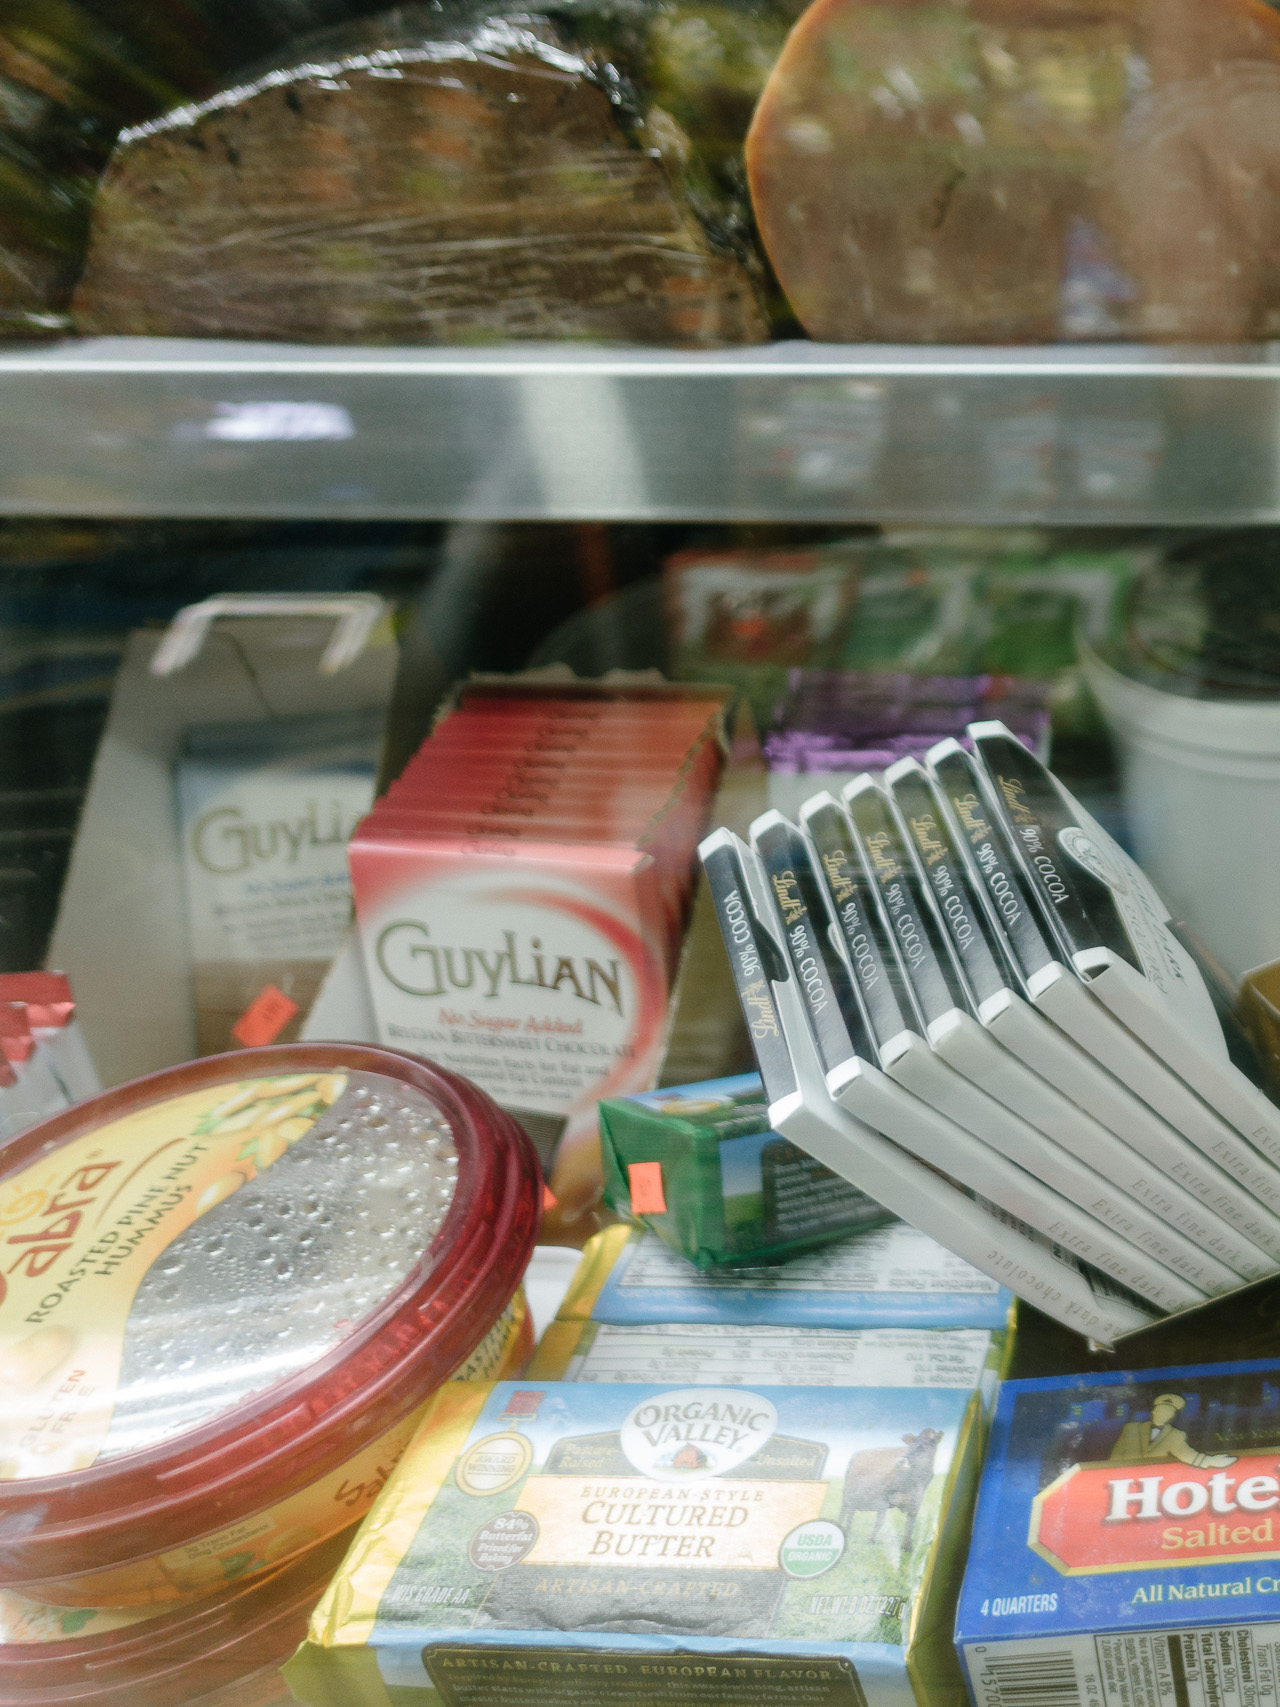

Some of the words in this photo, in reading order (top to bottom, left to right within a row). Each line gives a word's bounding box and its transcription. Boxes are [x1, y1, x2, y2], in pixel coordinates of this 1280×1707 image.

[866, 831, 895, 877] Lindt
[954, 793, 985, 839] Lindt
[976, 842, 1001, 875] 90%
[990, 872, 1023, 927] COCOA
[911, 813, 942, 860] Lindt
[932, 865, 955, 897] 90%
[944, 894, 976, 951] COCOA
[886, 883, 908, 916] 90%
[723, 889, 751, 945] COCOA
[823, 849, 853, 898] Lindt
[841, 902, 861, 935] 90%
[851, 933, 881, 992] COCOA
[772, 870, 800, 920] Lindt
[789, 925, 805, 959] 90%
[800, 957, 829, 1015] COCOA
[896, 914, 928, 970] COCOA
[735, 944, 761, 978] 90%
[437, 1008, 466, 1026] No
[470, 1010, 522, 1033] Sugar
[525, 1013, 584, 1035] Added
[748, 992, 779, 1040] Lindt
[1211, 1139, 1249, 1177] Extra
[1251, 1174, 1280, 1204] fine
[1170, 1161, 1211, 1197] Extra
[1213, 1193, 1242, 1222] fine
[1244, 1220, 1276, 1248] dark
[0, 1160, 123, 1306] abra
[25, 1229, 120, 1324] ROASTED
[116, 1181, 167, 1228] PINE
[163, 1143, 211, 1182] NUT
[95, 1182, 194, 1277] HUMMUS
[1131, 1178, 1172, 1215] Extra
[1174, 1209, 1207, 1239] fine
[1208, 1236, 1241, 1264] dark
[1091, 1198, 1133, 1233] Extra
[1136, 1228, 1169, 1258] fine
[1169, 1253, 1204, 1280] dark
[1048, 1221, 1092, 1255] Extra
[1094, 1248, 1128, 1277] fine
[1131, 1273, 1167, 1300] dark
[986, 1248, 1063, 1304] chocolate
[634, 1401, 769, 1432] ORGANIC
[642, 1421, 748, 1451] VALLEY
[467, 1463, 517, 1473] WINNING
[475, 1455, 518, 1464] AWARD
[756, 1452, 818, 1468] Unsalted
[580, 1486, 767, 1503] EUROPEAN-STYLE
[494, 1517, 530, 1531] 84%
[581, 1500, 750, 1529] CULTURED
[477, 1530, 536, 1542] Butterfat
[587, 1530, 717, 1559] BUTTER
[796, 1533, 833, 1546] USDA
[1161, 1518, 1274, 1551] Salted
[787, 1550, 833, 1562] ORGANIC
[414, 1586, 454, 1604] GRADE
[452, 1588, 471, 1605] AA
[533, 1577, 739, 1597] ARTISAN-CRAFTED
[1132, 1583, 1163, 1605] All
[1167, 1576, 1253, 1602] Natural
[980, 1599, 989, 1617] 4
[991, 1593, 1059, 1617] QUARTERS
[1101, 1640, 1113, 1659] 2,000
[1138, 1637, 1147, 1649] Not
[1183, 1633, 1196, 1668] Protein
[1200, 1632, 1213, 1656] Total
[1218, 1631, 1231, 1666] Sodium
[1236, 1629, 1253, 1683] Cholesterol
[1256, 1644, 1270, 1668] Trans
[442, 1656, 628, 1676] ARTISAN-CRAFTED
[641, 1664, 748, 1678] EUROPEAN
[1105, 1659, 1117, 1681] calorie
[1116, 1667, 1127, 1683] Daily
[1153, 1635, 1167, 1670] Vitamin
[1160, 1681, 1171, 1696] 8%
[1184, 1670, 1199, 1682] 0g
[1223, 1667, 1235, 1693] 90mg
[1259, 1669, 1271, 1683] Fat
[1259, 1684, 1273, 1696] 0g
